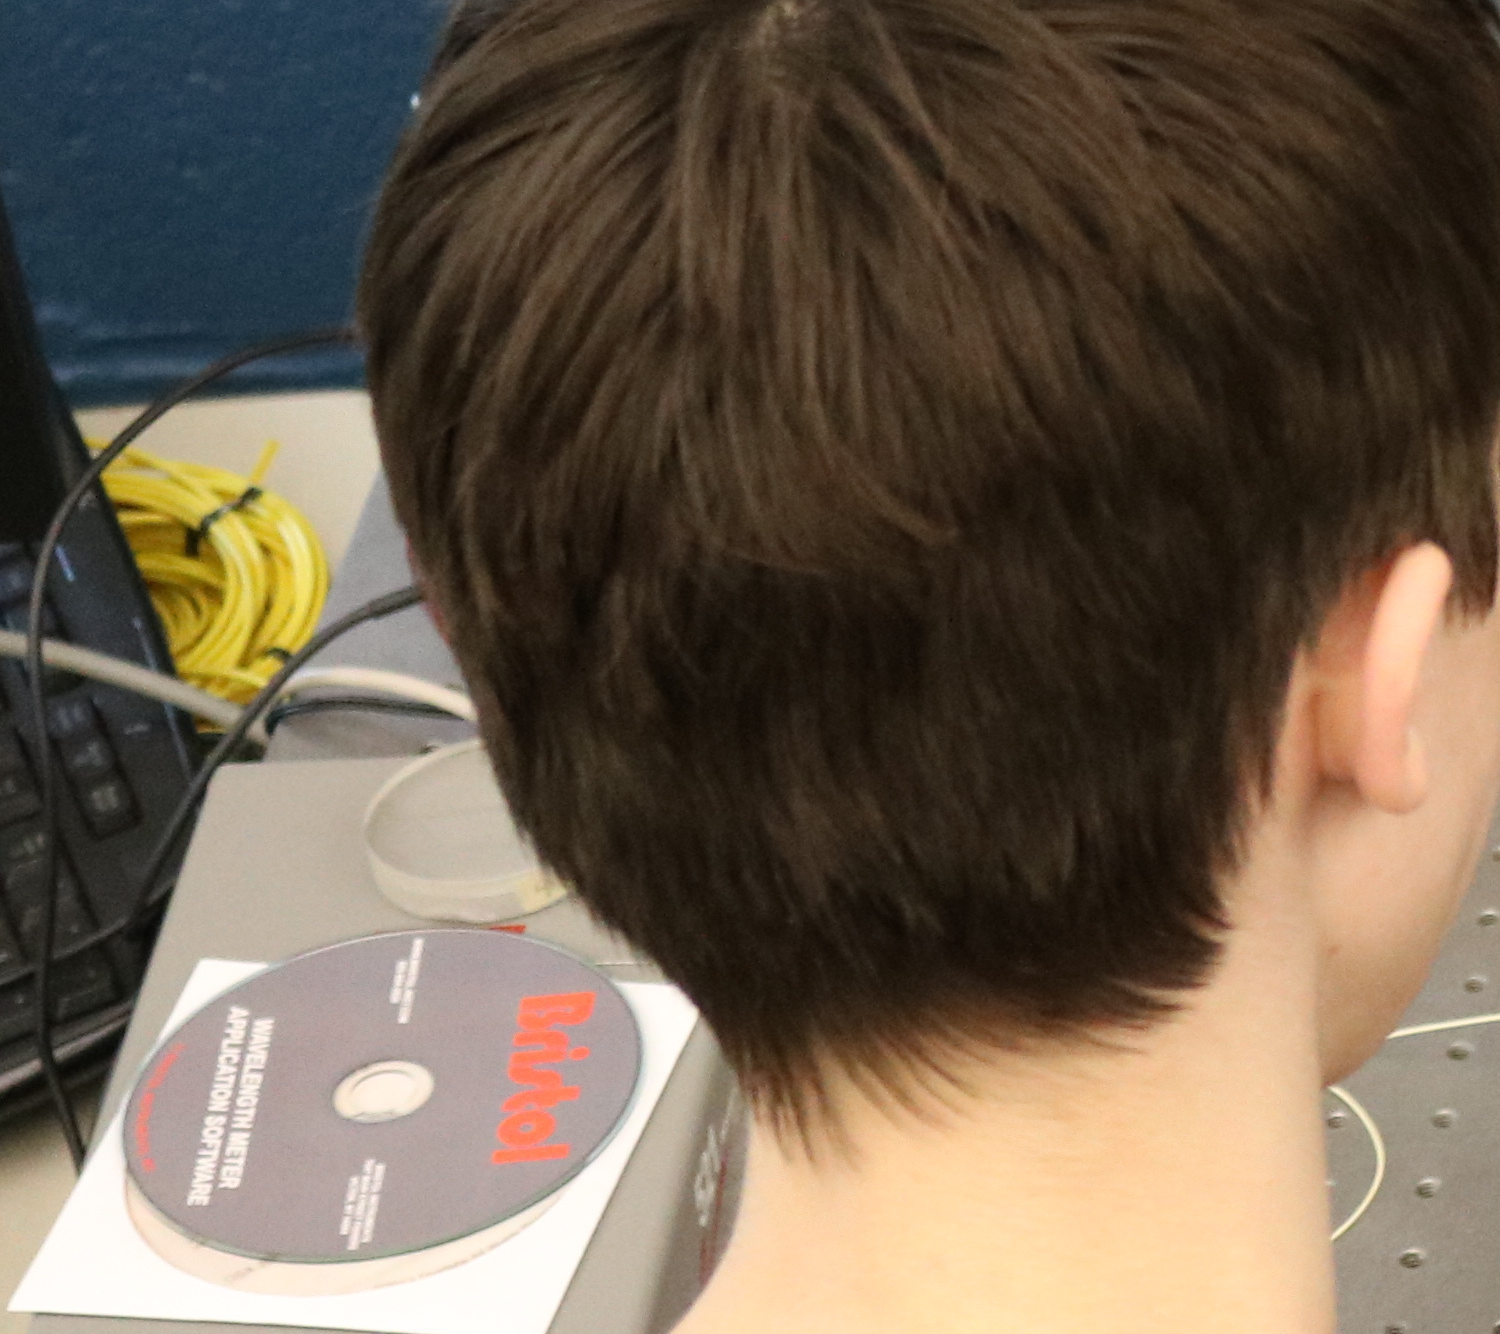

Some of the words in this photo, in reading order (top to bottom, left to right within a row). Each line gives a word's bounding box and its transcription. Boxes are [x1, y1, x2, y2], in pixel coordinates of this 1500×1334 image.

[207, 1005, 249, 1112] APPLICATION
[231, 1018, 275, 1129] WAVELENGTH
[491, 992, 597, 1165] Bristol
[186, 1115, 227, 1206] SOFTWARE
[217, 1131, 251, 1189] METER
